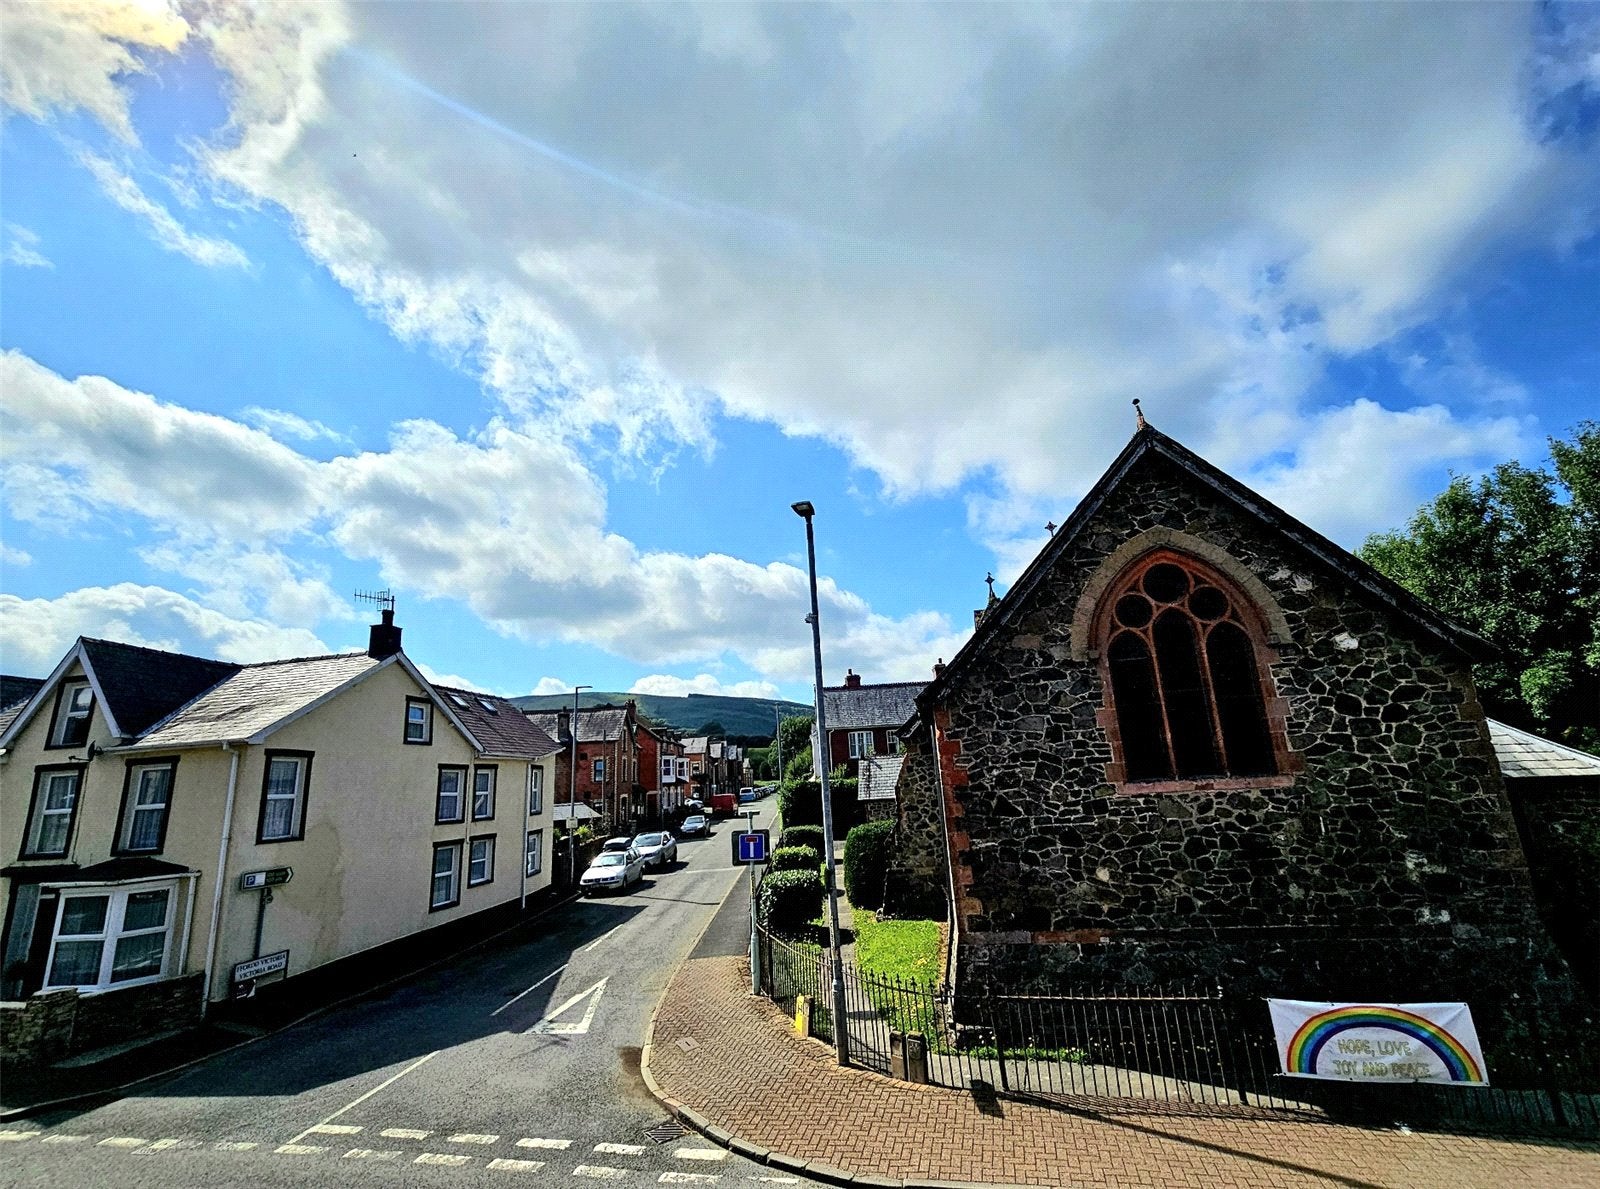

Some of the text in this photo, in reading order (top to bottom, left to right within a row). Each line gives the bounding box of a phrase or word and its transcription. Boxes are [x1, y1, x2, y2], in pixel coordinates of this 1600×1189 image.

[248, 876, 254, 884] P
[236, 954, 286, 973] FFORDD VICTORIA
[239, 962, 283, 979] VICTORIA ROAD
[1337, 1039, 1412, 1057] HOPE, LOVE
[1333, 1060, 1431, 1078] JOY AND PEACE
